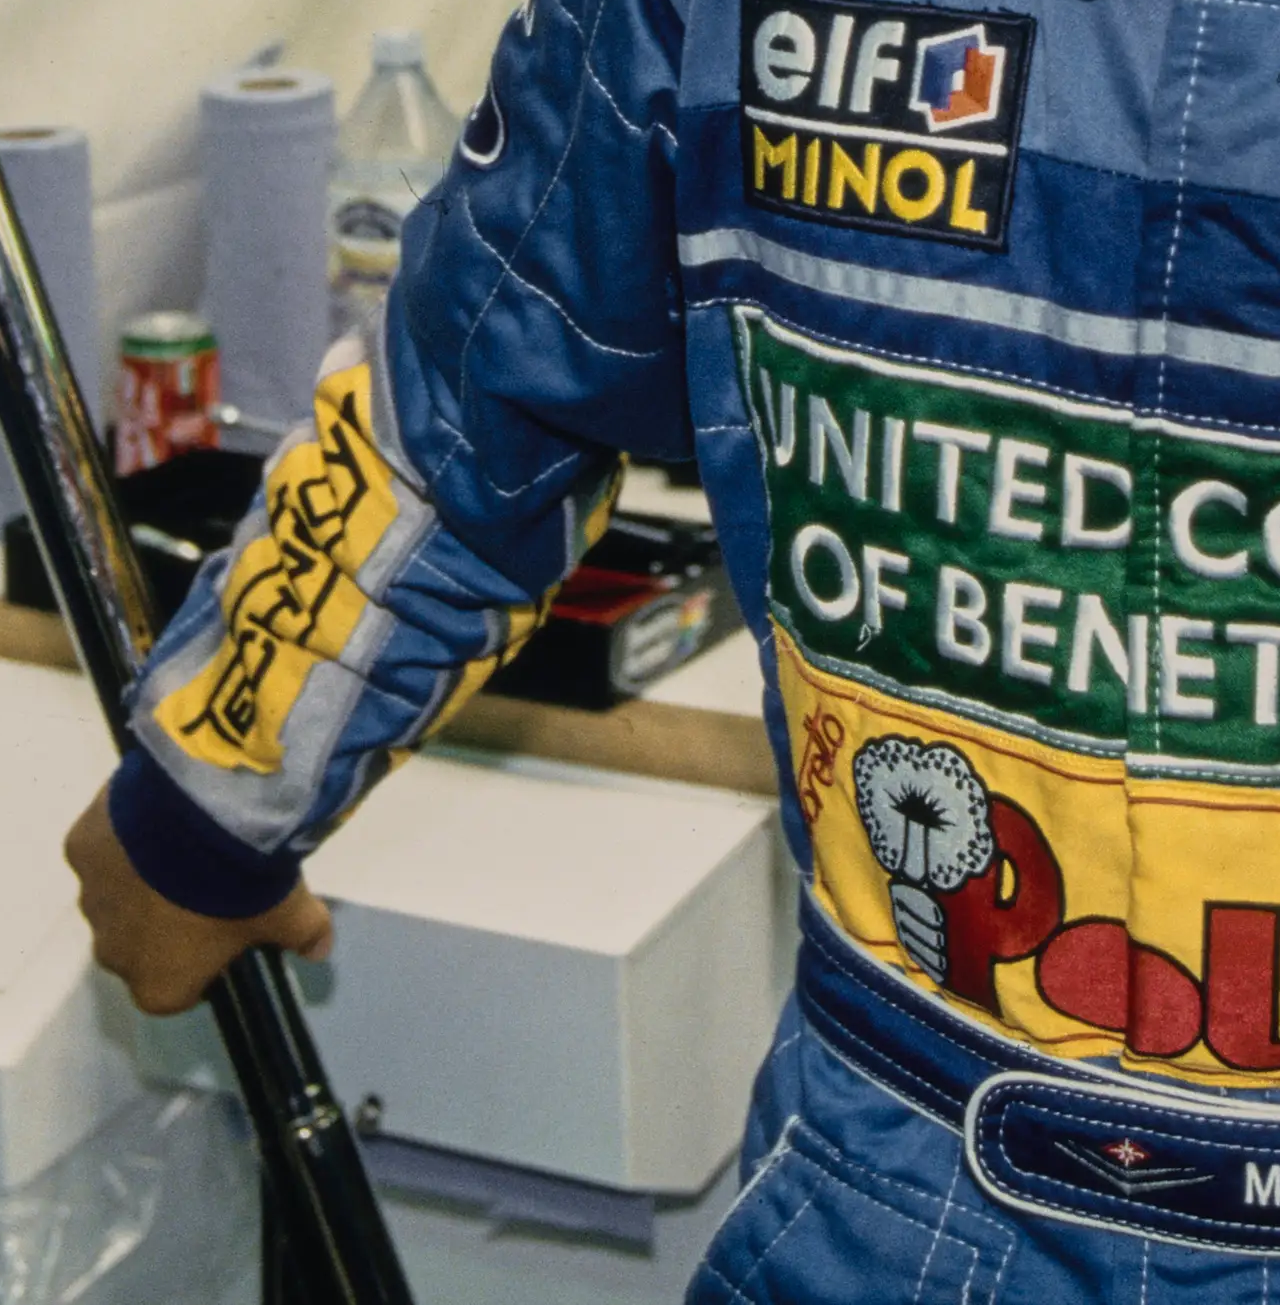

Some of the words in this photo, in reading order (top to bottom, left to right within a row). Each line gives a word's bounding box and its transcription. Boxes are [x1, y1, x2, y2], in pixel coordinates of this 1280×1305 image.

[753, 10, 906, 113] elf
[752, 123, 988, 235] MINOL
[760, 366, 1132, 549] UNITED
[790, 524, 911, 629] OF
